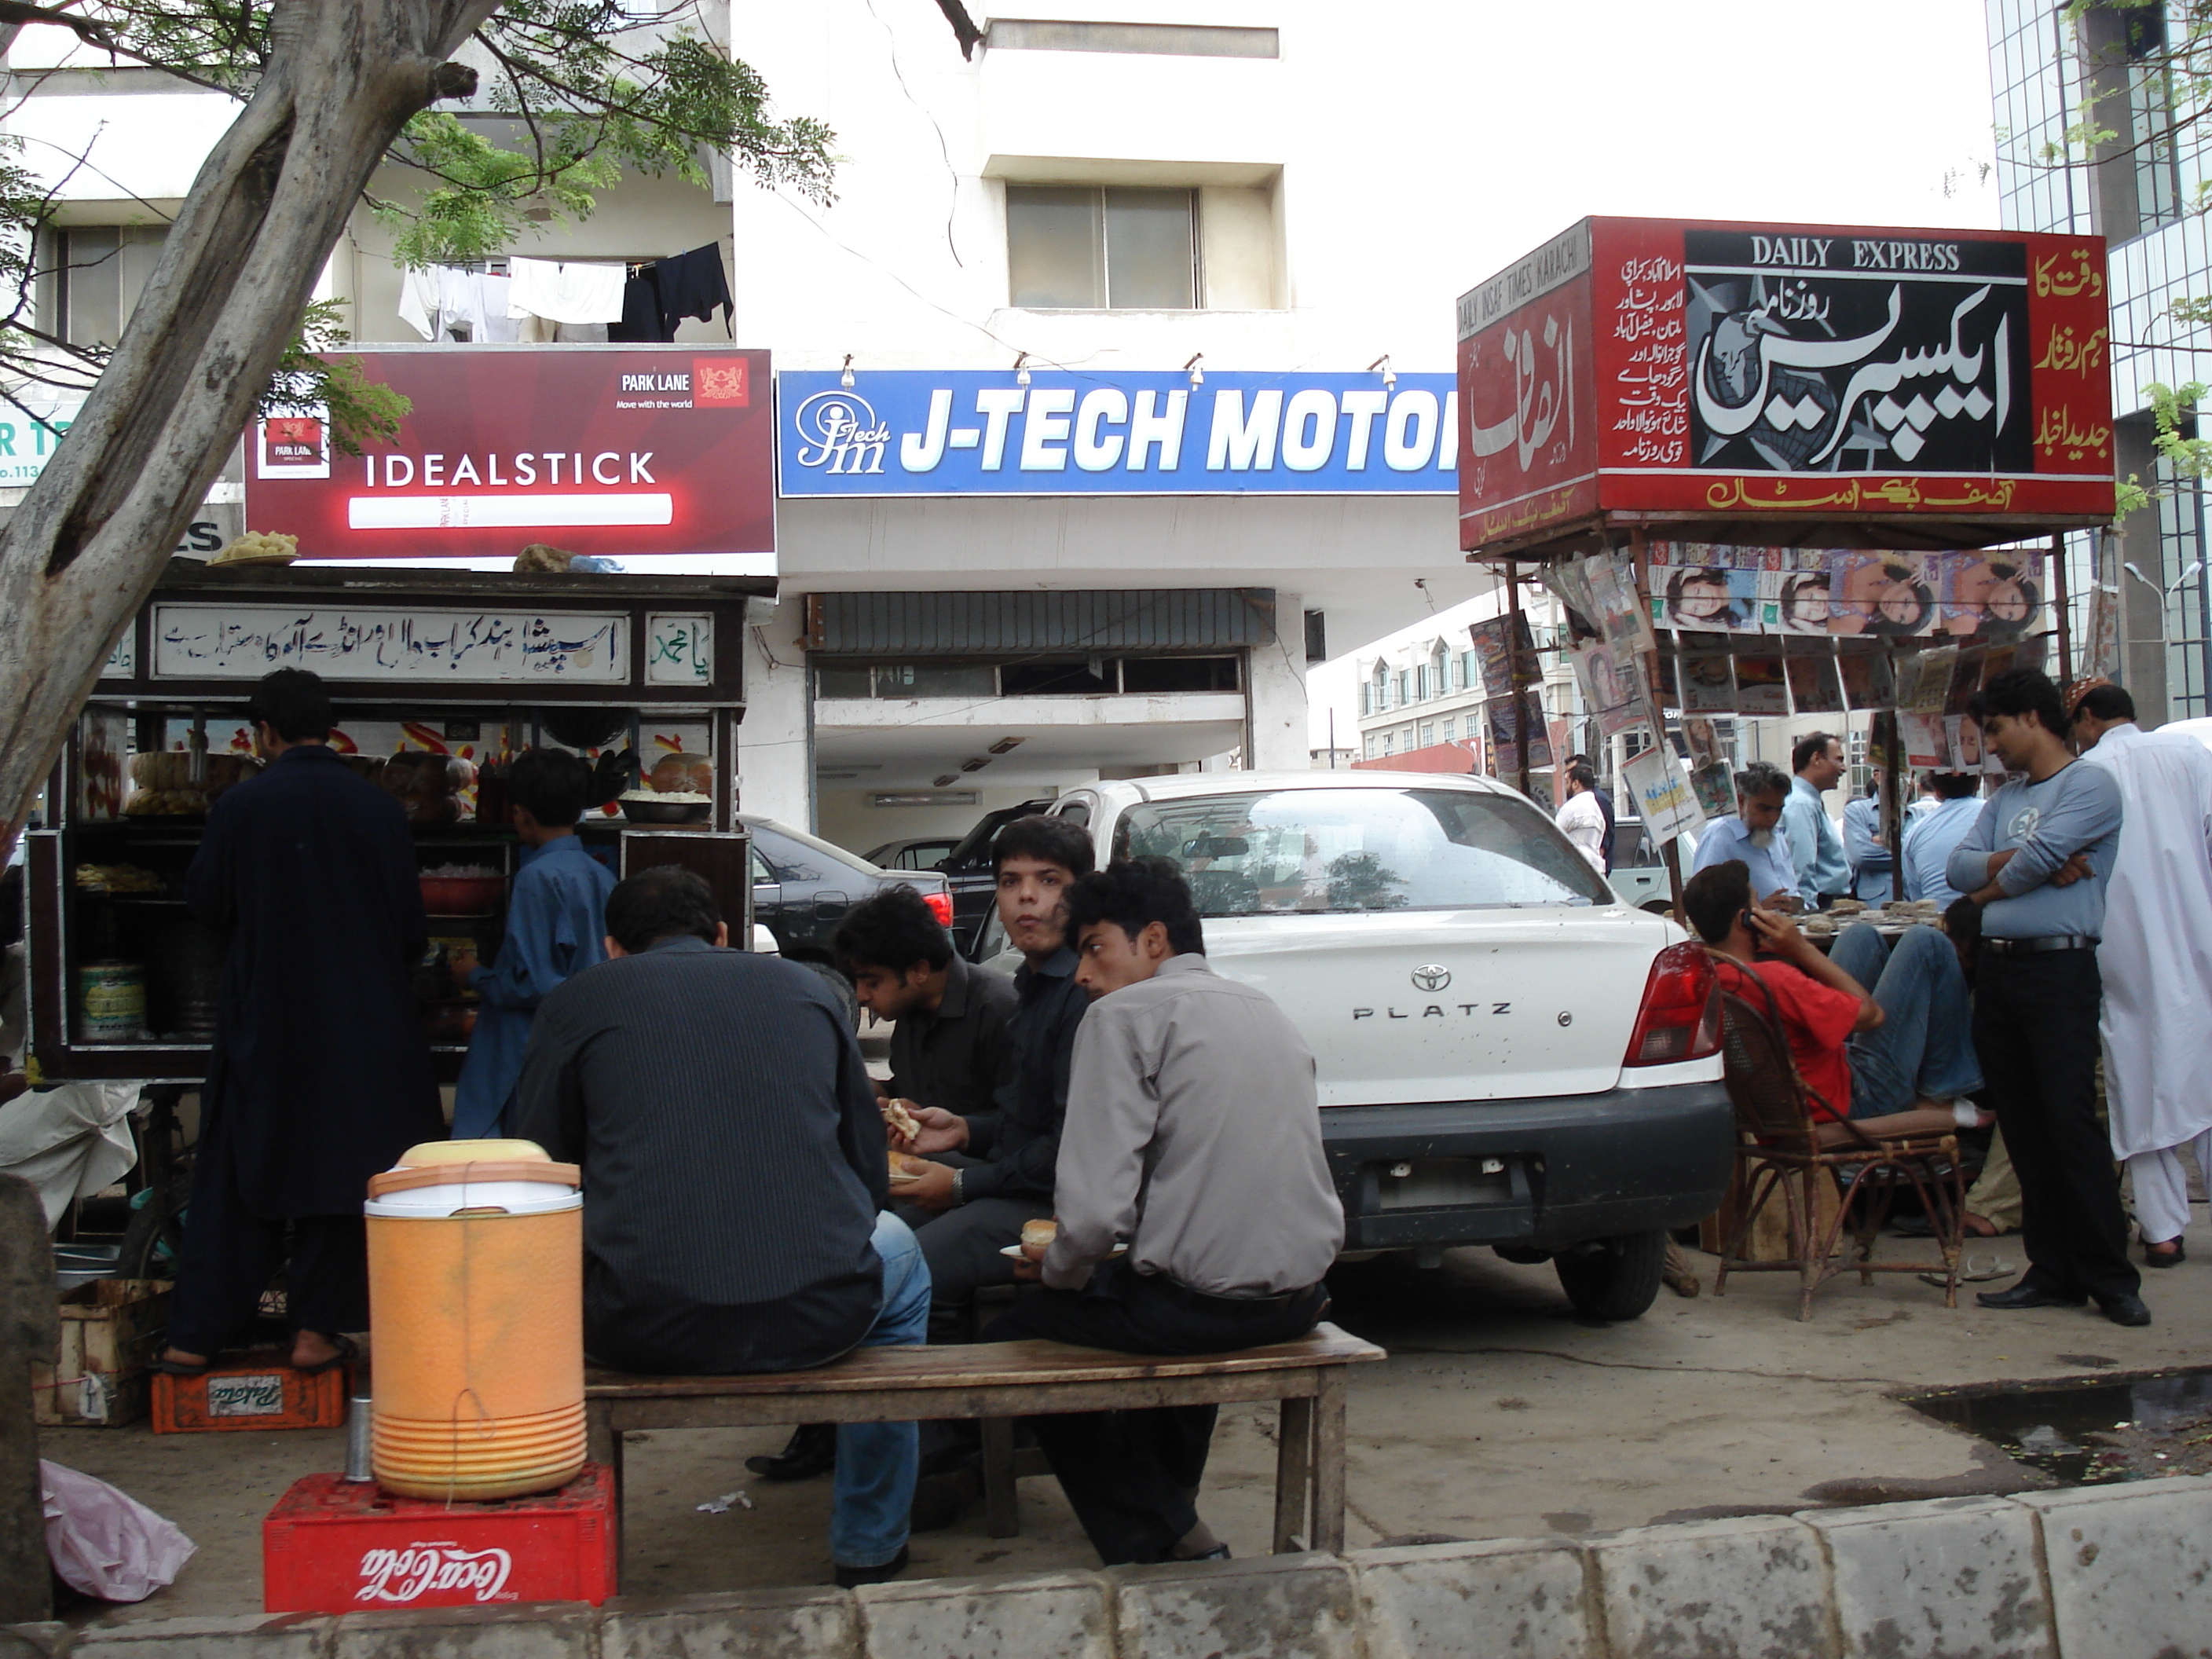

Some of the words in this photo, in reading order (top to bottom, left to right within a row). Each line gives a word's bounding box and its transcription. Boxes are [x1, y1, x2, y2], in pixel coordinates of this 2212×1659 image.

[1750, 236, 1833, 268] DAILY
[1852, 240, 1961, 272] EXPRESS
[1459, 295, 1478, 333] DAILY
[1507, 263, 1532, 305] TIMES
[1537, 236, 1578, 288] KARACHI
[2052, 249, 2103, 297] وقت
[622, 374, 655, 392] PARK
[657, 374, 690, 392] LANE
[1695, 282, 2011, 465] ایکسپریس
[616, 401, 637, 409] Move
[638, 400, 655, 408] with
[656, 400, 669, 408] the
[670, 399, 694, 409] world
[899, 388, 1188, 472] J-TECH
[1205, 388, 1459, 472] MOTO
[275, 446, 293, 456] PARK
[365, 451, 657, 488] IDEALSTICK
[1353, 1002, 1512, 1020] PLATZ
[213, 1382, 281, 1407] Pakola
[353, 1547, 511, 1602] Coca-Cola
